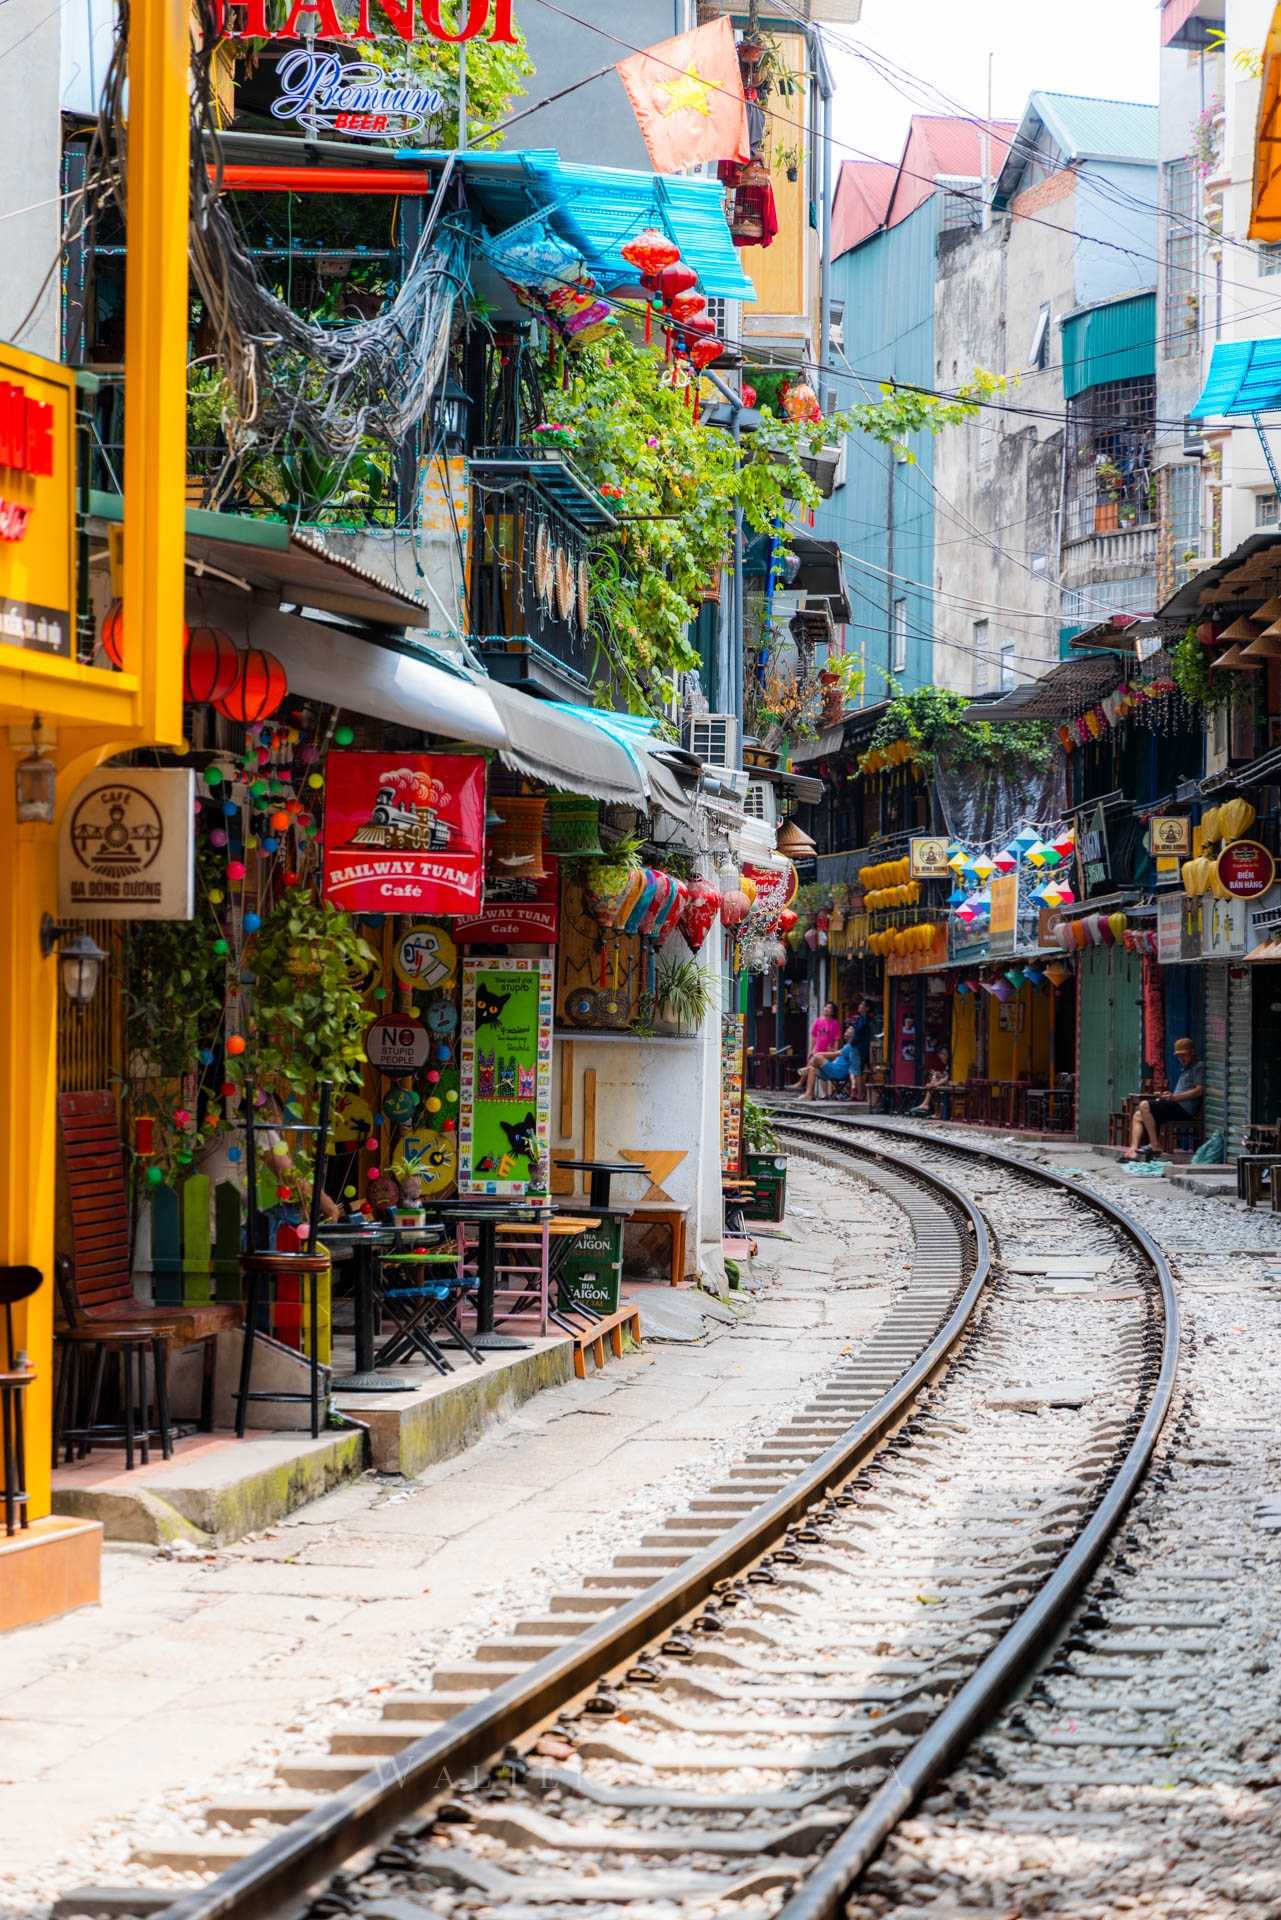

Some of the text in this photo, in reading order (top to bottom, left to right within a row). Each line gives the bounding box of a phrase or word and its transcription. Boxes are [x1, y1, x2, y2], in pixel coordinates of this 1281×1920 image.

[271, 49, 444, 119] Premium
[334, 112, 390, 131] BEER
[330, 861, 469, 885] RAILWAY TUAN
[517, 909, 551, 925] TUAN
[382, 1027, 415, 1047] NO
[380, 1055, 415, 1065] PEOPLE
[382, 1047, 415, 1056] STUPID
[574, 1240, 610, 1250] AIGON
